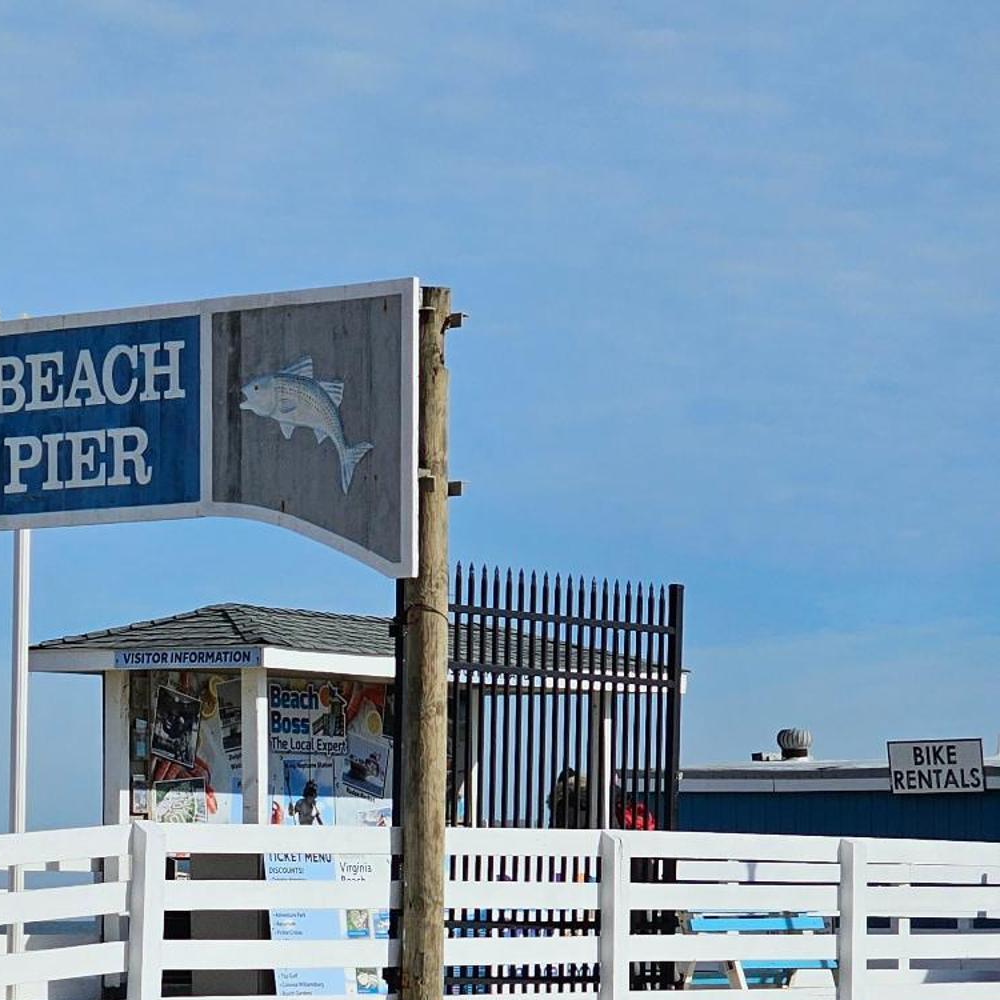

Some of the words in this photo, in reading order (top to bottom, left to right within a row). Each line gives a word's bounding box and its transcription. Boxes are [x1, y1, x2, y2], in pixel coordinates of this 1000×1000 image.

[3, 426, 154, 496] PIER
[123, 652, 168, 664] VISITOR
[170, 650, 251, 663] INFORMATION
[270, 685, 319, 710] Beach
[271, 711, 310, 735] Boss
[271, 737, 289, 749] The
[290, 738, 314, 751] Local
[317, 738, 346, 755] Expert
[913, 746, 957, 766] BIKE
[894, 768, 981, 790] RENTALS
[304, 853, 332, 863] MENU
[339, 862, 373, 875] Virginia
